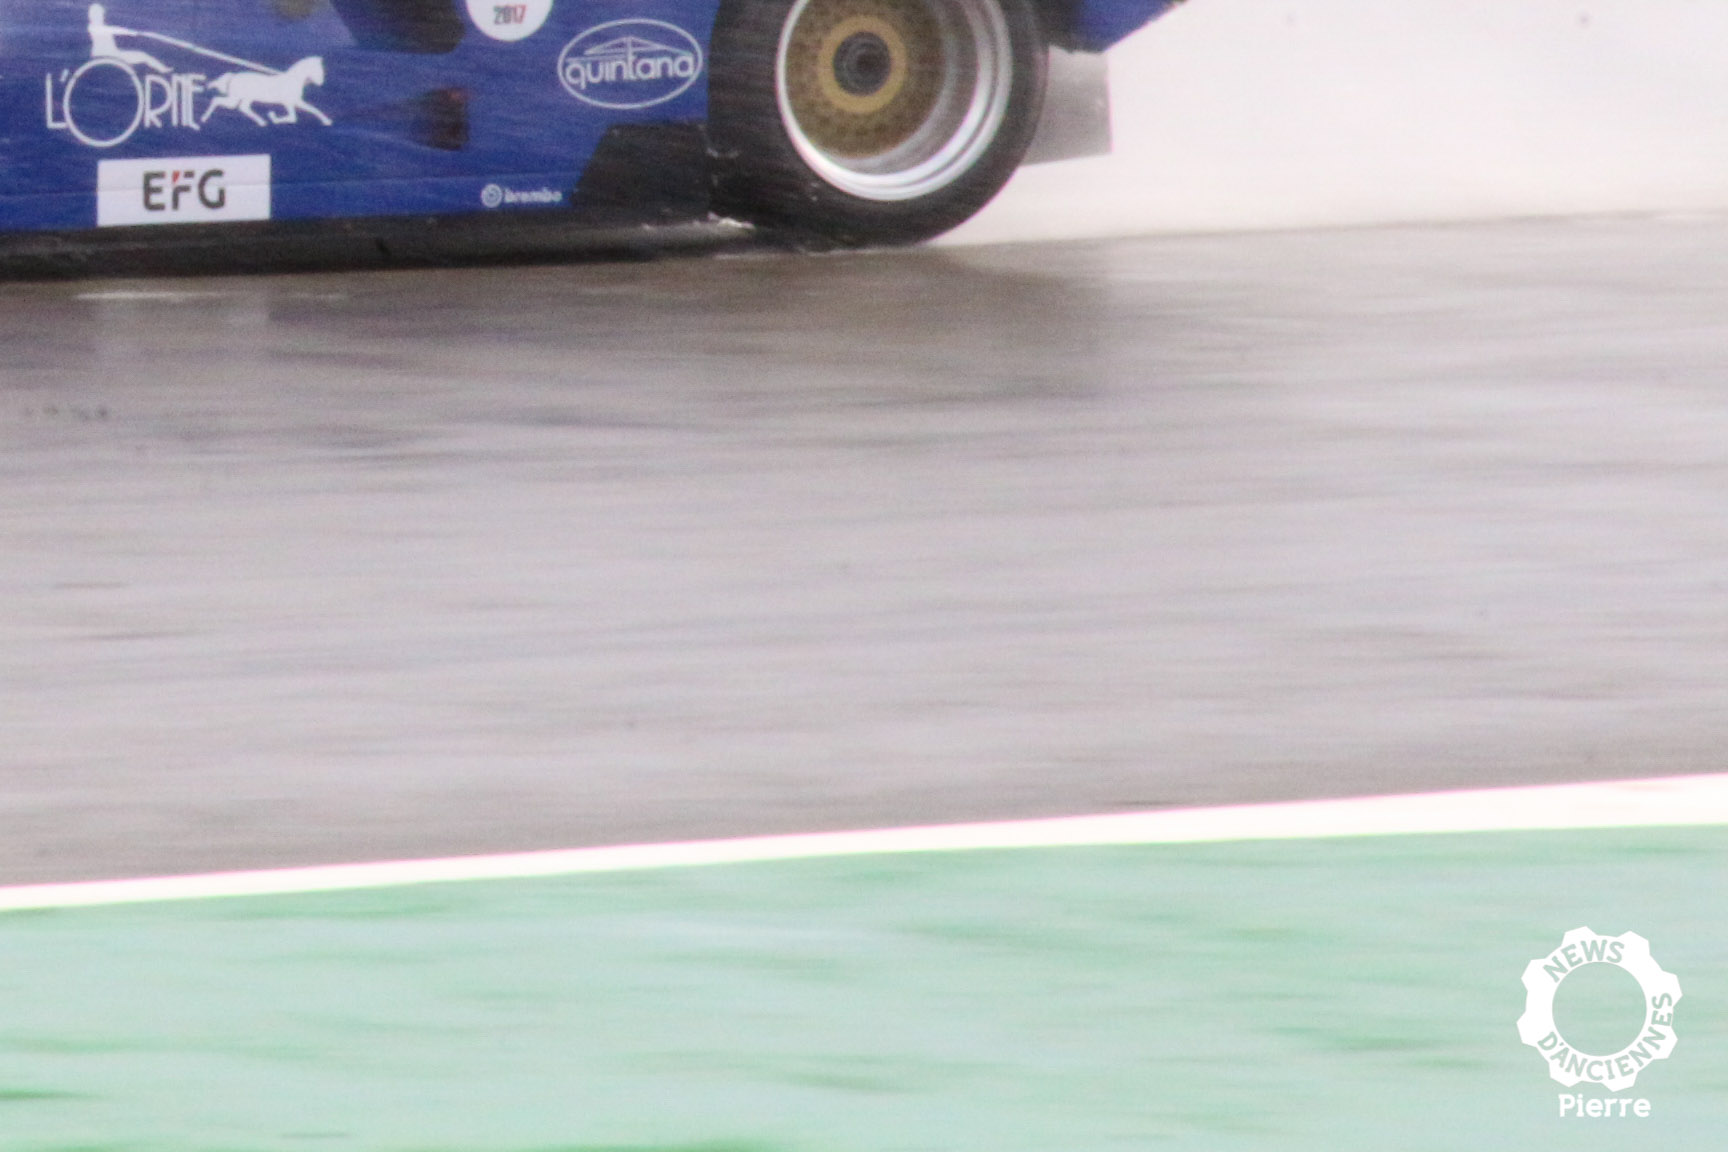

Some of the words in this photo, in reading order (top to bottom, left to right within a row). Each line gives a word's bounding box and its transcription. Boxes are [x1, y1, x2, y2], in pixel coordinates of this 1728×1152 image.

[493, 3, 527, 25] 2017
[564, 48, 695, 90] quintana
[143, 169, 226, 211] EFG
[504, 186, 563, 204] brembo
